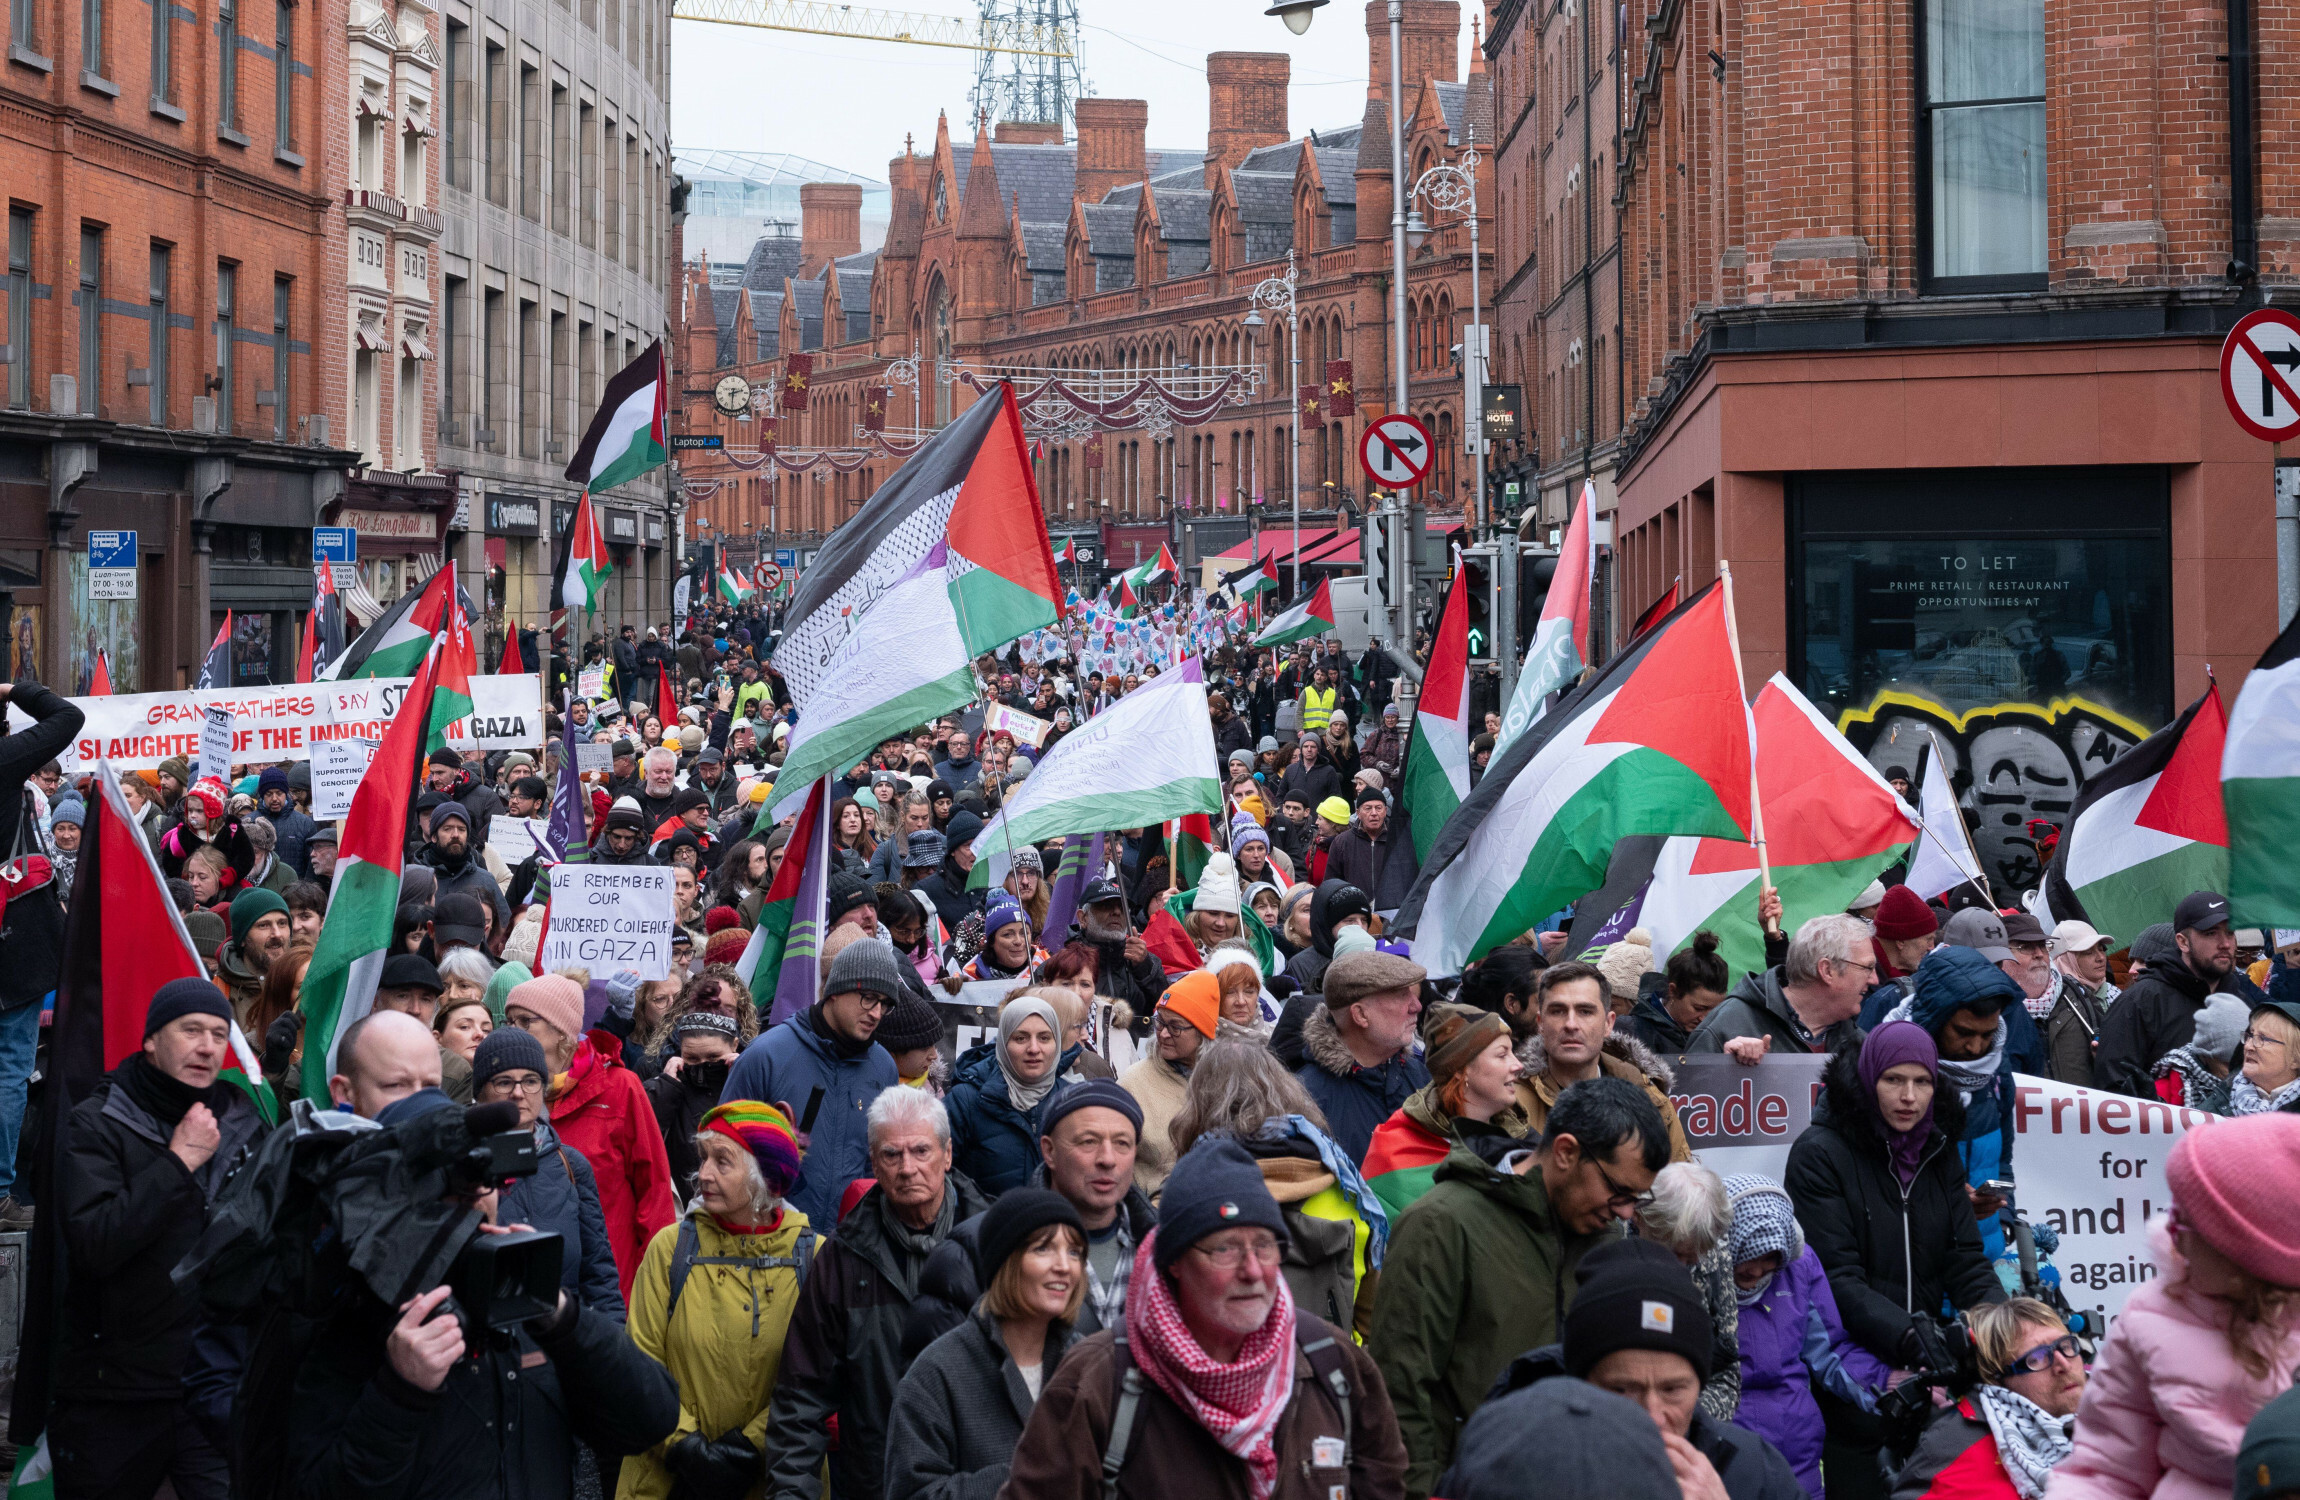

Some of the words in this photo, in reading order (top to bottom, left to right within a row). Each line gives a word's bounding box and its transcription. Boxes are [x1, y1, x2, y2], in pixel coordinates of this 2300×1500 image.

[1486, 414, 1514, 422] HOTEL
[674, 437, 720, 449] LaptopLab
[347, 512, 368, 529] The
[371, 513, 400, 536] Long
[399, 514, 421, 533] Hall
[1940, 556, 1967, 570] TO
[1981, 556, 2017, 570] LET
[1889, 581, 1925, 590] PRIME
[1931, 581, 1973, 590] RETAIL
[1989, 581, 2070, 590] RESTAURANT
[1918, 597, 2020, 607] OPPORTUNITIES
[2025, 597, 2041, 606] AT
[339, 690, 369, 711] SAY
[78, 733, 201, 761] SLAUGHTE
[259, 726, 303, 750] THE
[470, 716, 527, 739] GAZA
[576, 745, 597, 753] FREE
[315, 767, 363, 776] SUPPORTING
[321, 778, 359, 787] GENOCIDE
[584, 873, 664, 890] REMEMBER
[588, 892, 620, 905] OUR
[554, 941, 571, 959] IN
[579, 938, 656, 962] GAZA
[1669, 1077, 1790, 1137] rade
[2099, 1151, 2148, 1179] for
[2045, 1198, 2125, 1235] and
